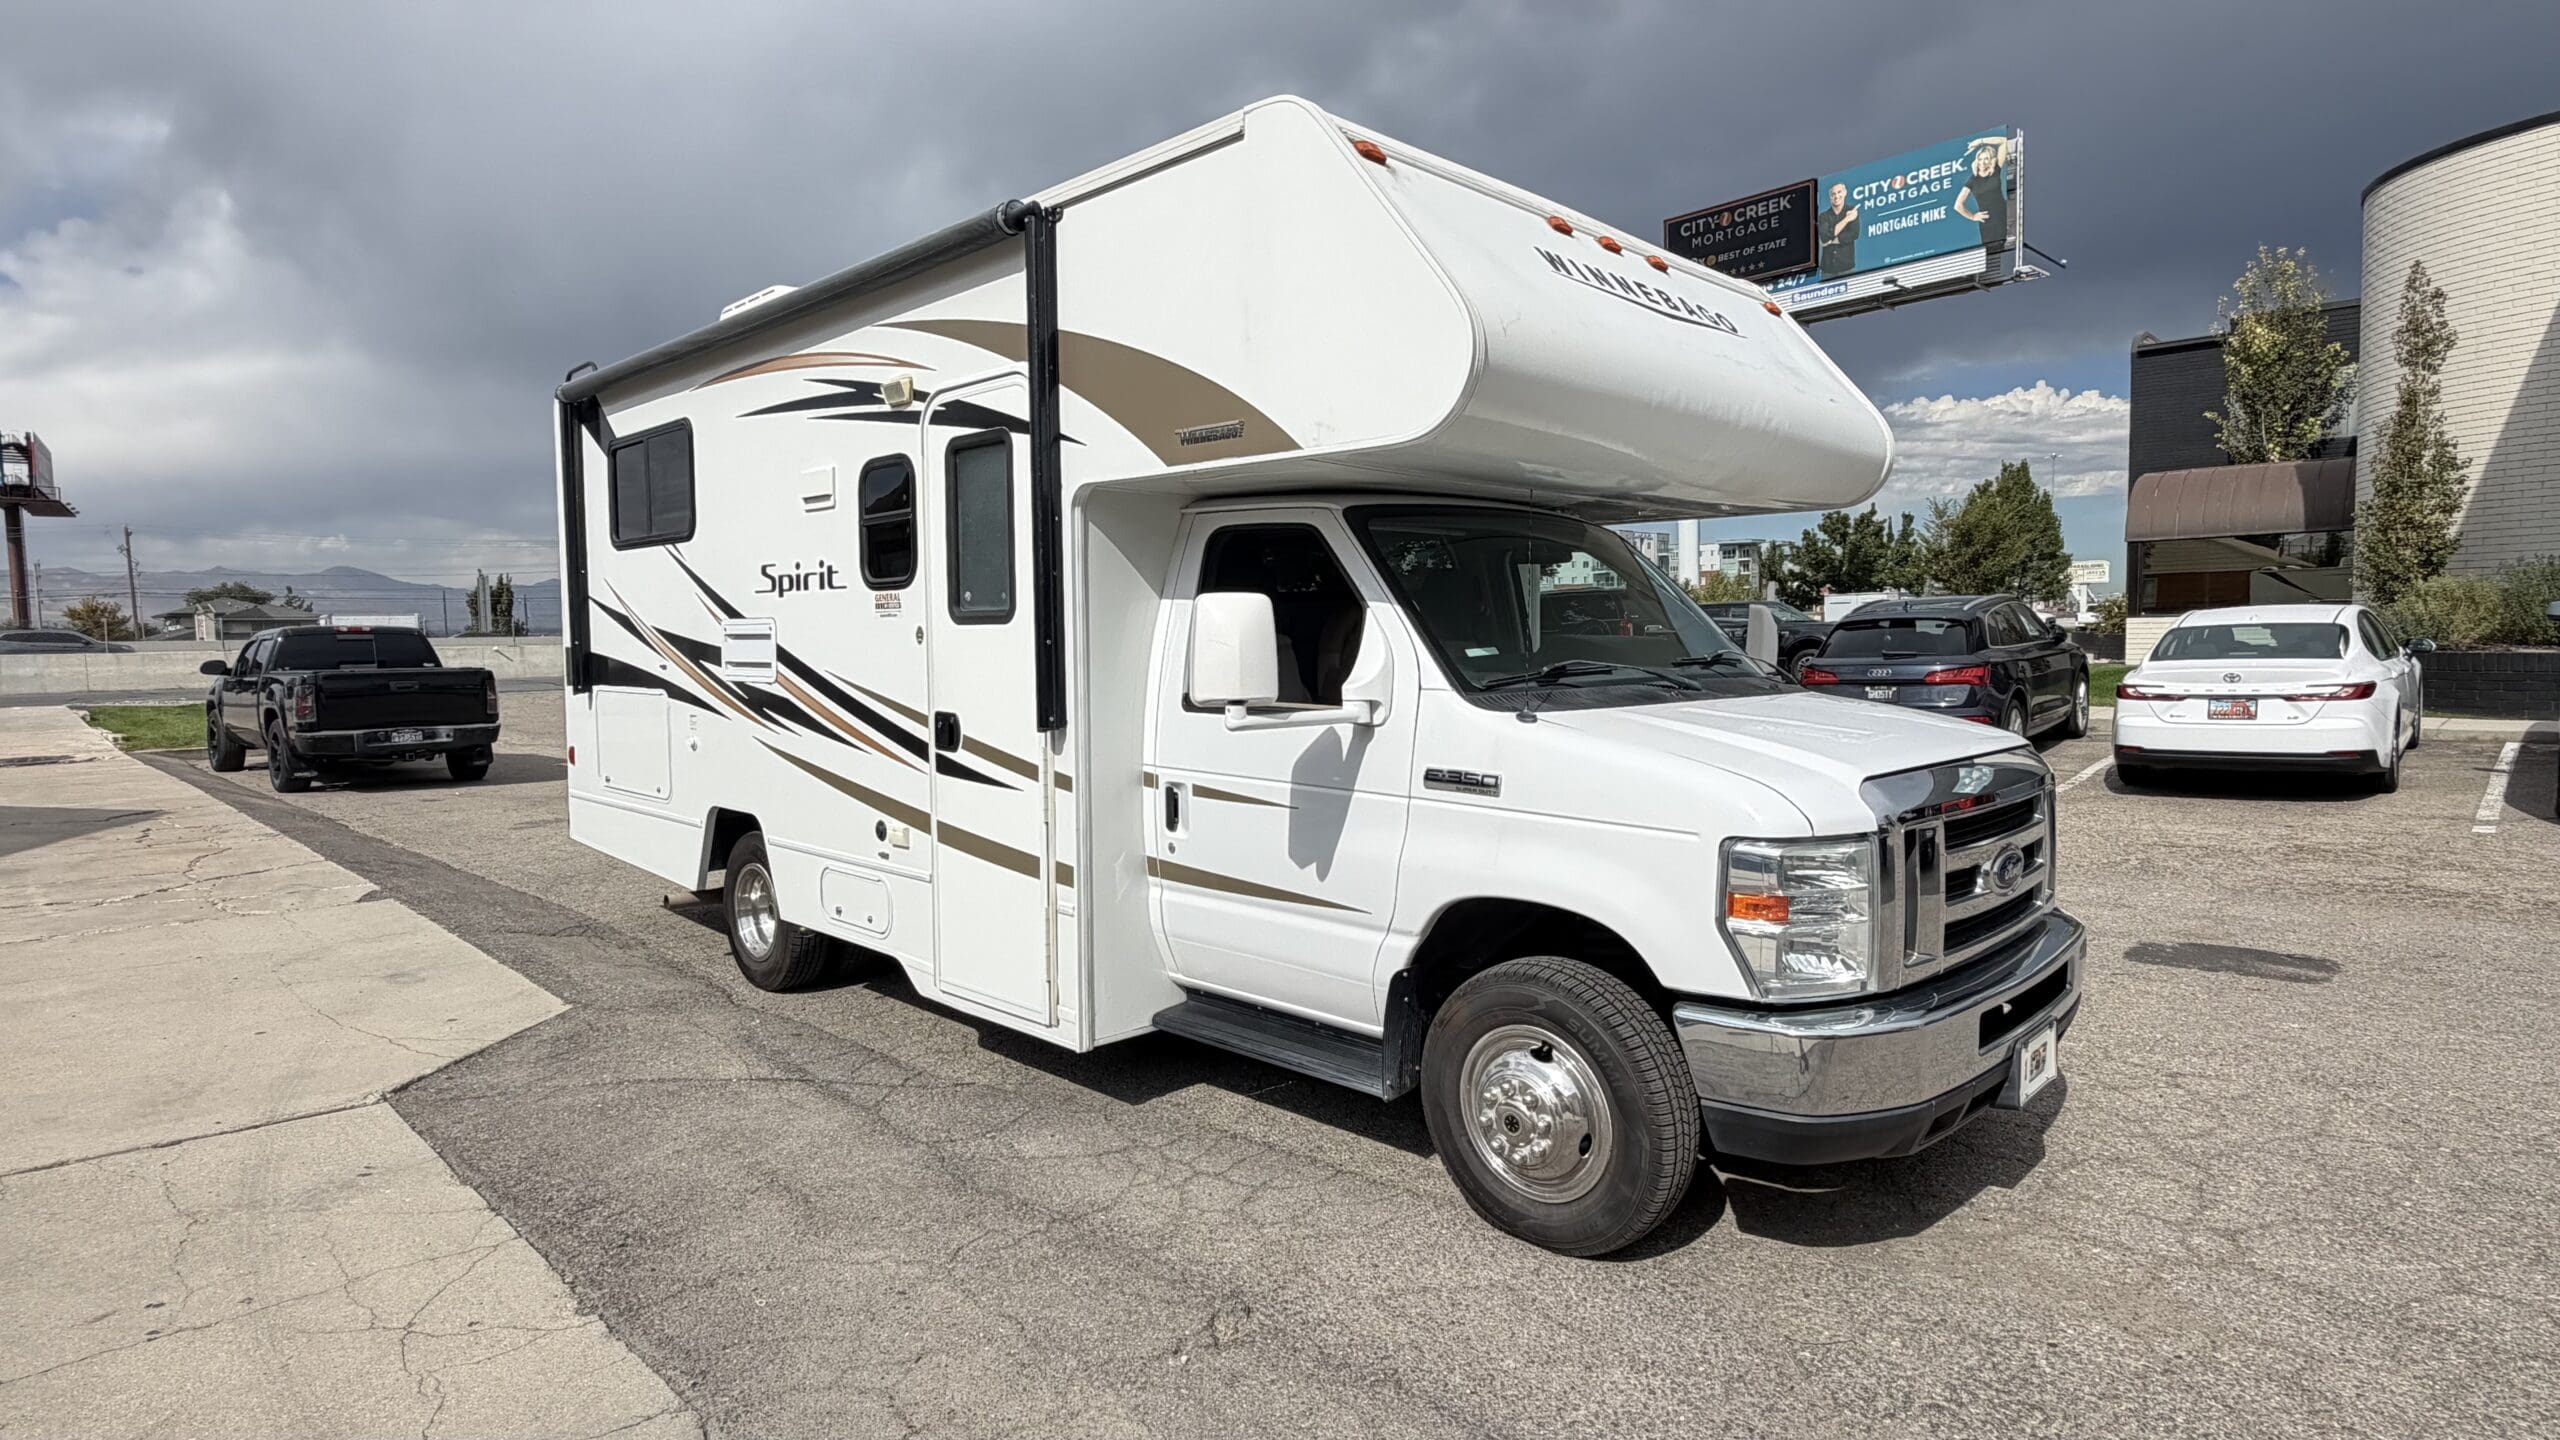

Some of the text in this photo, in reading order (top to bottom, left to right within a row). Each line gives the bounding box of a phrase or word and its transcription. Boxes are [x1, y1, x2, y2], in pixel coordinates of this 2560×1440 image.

[1853, 158, 1965, 200] CITY CREEK
[1864, 178, 1952, 210] MORTGAGE
[1680, 194, 1792, 237] CITY CREEK
[1868, 206, 1947, 237] MORTGAGE MIKE
[1691, 216, 1780, 248] MORTGAGE
[1717, 250, 1741, 262] BEST
[1742, 245, 1758, 256] OF
[1758, 238, 1788, 253] STATE
[1534, 246, 1739, 334] WINNEBAGO
[1777, 274, 1806, 289] 24/7
[1793, 284, 1846, 302] Saunders
[755, 559, 848, 598] Spirit
